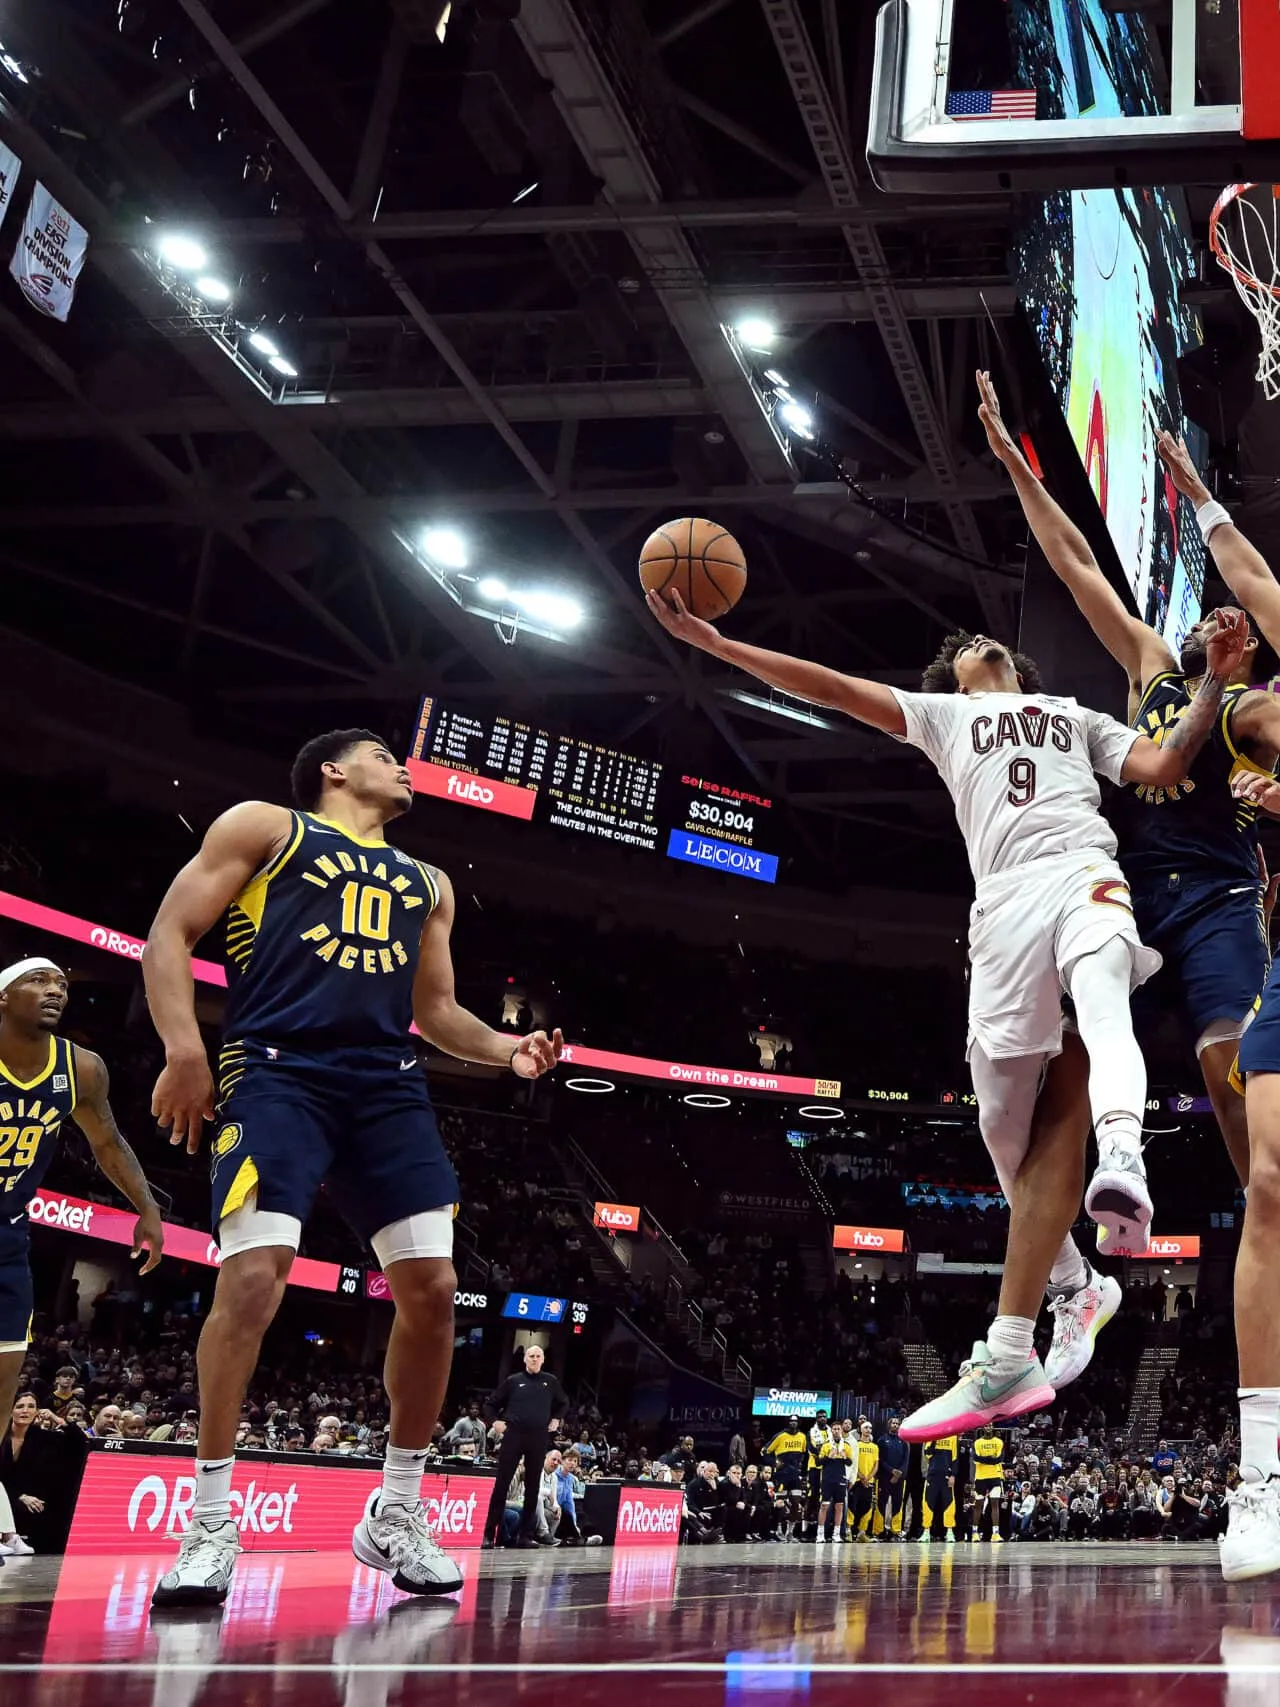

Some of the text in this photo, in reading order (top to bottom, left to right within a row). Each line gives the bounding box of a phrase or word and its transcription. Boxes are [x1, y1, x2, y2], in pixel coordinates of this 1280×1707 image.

[33, 227, 71, 271] DIVISION
[44, 222, 68, 249] EAST
[23, 236, 74, 289] CHAMPIONS
[1175, 577, 1193, 653] CLIFFS
[971, 713, 1073, 755] CAVS
[430, 756, 451, 768] TEAM
[447, 775, 494, 804] fubo
[1007, 757, 1037, 808] 9
[721, 786, 773, 809] RAFFLE
[556, 801, 573, 814] THE
[574, 806, 617, 825] OVERTIME.
[619, 818, 640, 831] LAST
[640, 823, 658, 836] TWO
[689, 800, 754, 833] $30,904
[550, 814, 656, 850] MINUTES IN THE OVERTIME.
[685, 821, 753, 846] CAVS.COM/RAFFLE
[301, 851, 424, 910] INDIANA
[340, 880, 393, 942] 10
[300, 922, 409, 974] PACERS
[669, 1064, 778, 1090] Own the Dream
[867, 1089, 910, 1101] $30,904
[0, 1125, 45, 1168] 29
[28, 1196, 94, 1233] ocket
[600, 1206, 634, 1227] fubo
[852, 1230, 884, 1248] fubo
[1150, 1240, 1182, 1254] fubo
[341, 1279, 357, 1293] 40
[342, 1267, 360, 1279] FG%
[517, 1298, 529, 1315] 5
[571, 1310, 587, 1324] 39
[572, 1301, 589, 1312] FG%
[767, 1388, 818, 1404] SHERWIN
[103, 1439, 125, 1450] anc
[167, 1475, 298, 1534] Rcket
[631, 1500, 680, 1533] Rocket
